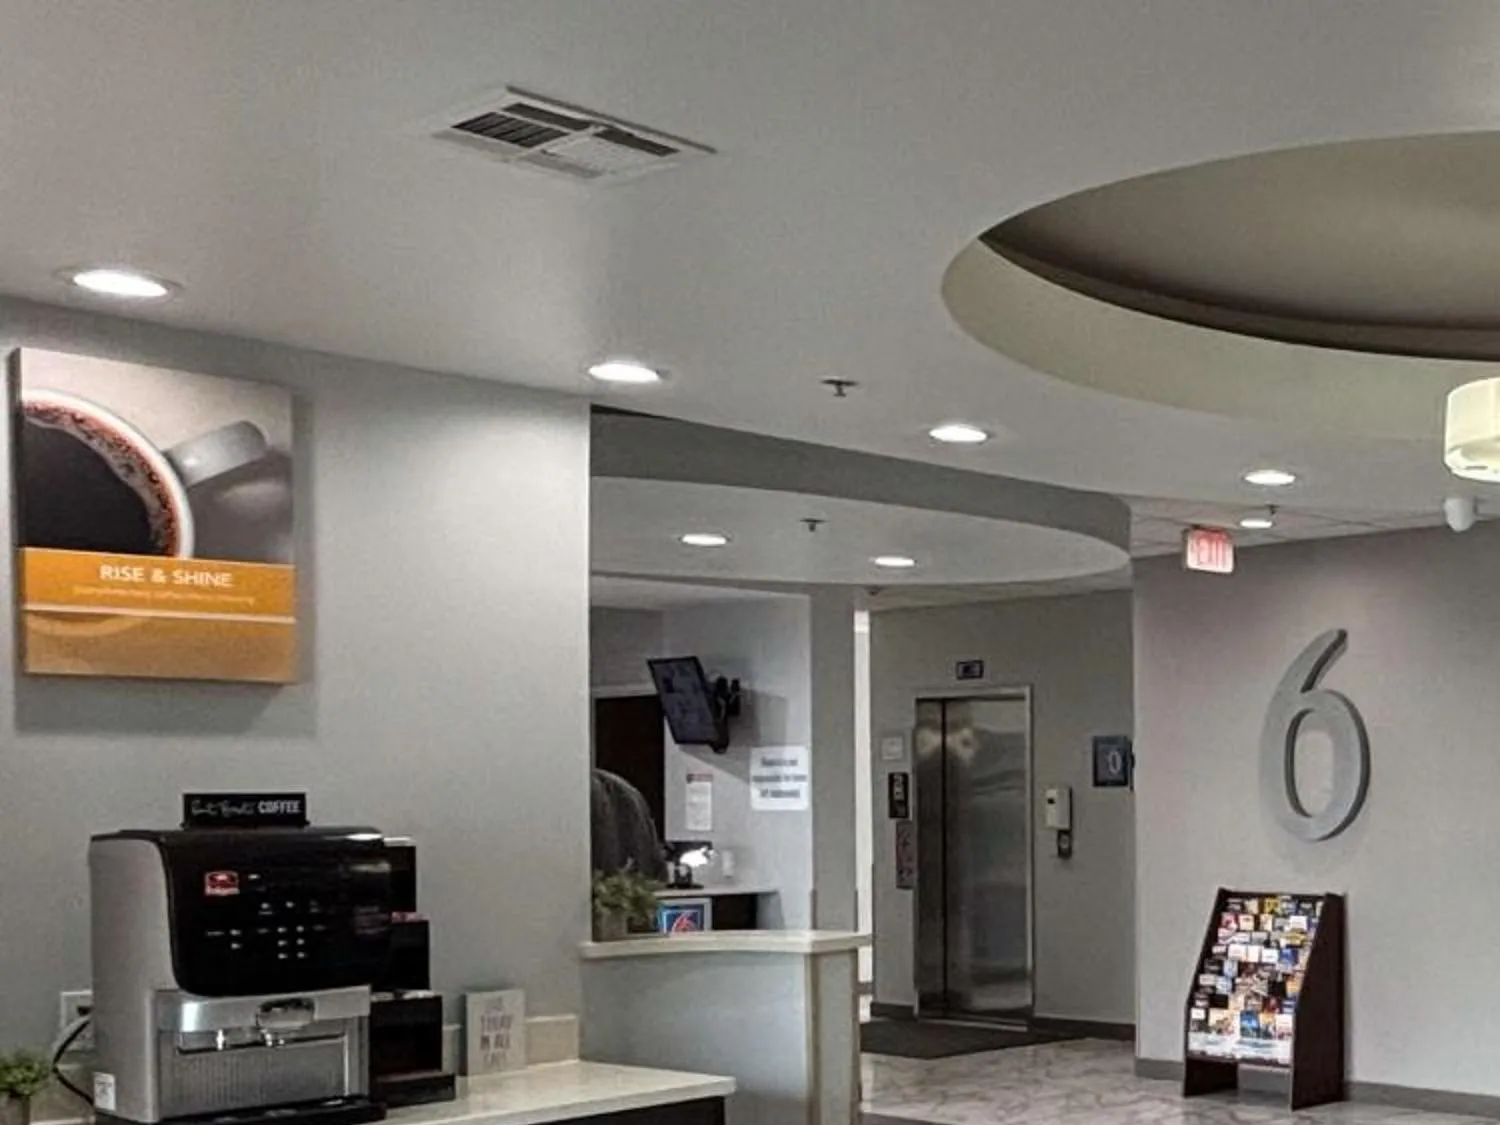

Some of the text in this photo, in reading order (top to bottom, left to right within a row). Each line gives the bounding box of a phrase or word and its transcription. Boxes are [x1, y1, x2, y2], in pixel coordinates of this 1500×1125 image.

[100, 565, 234, 587] RISE & SHINE
[1259, 628, 1371, 841] 6
[258, 799, 300, 814] COFFEE
